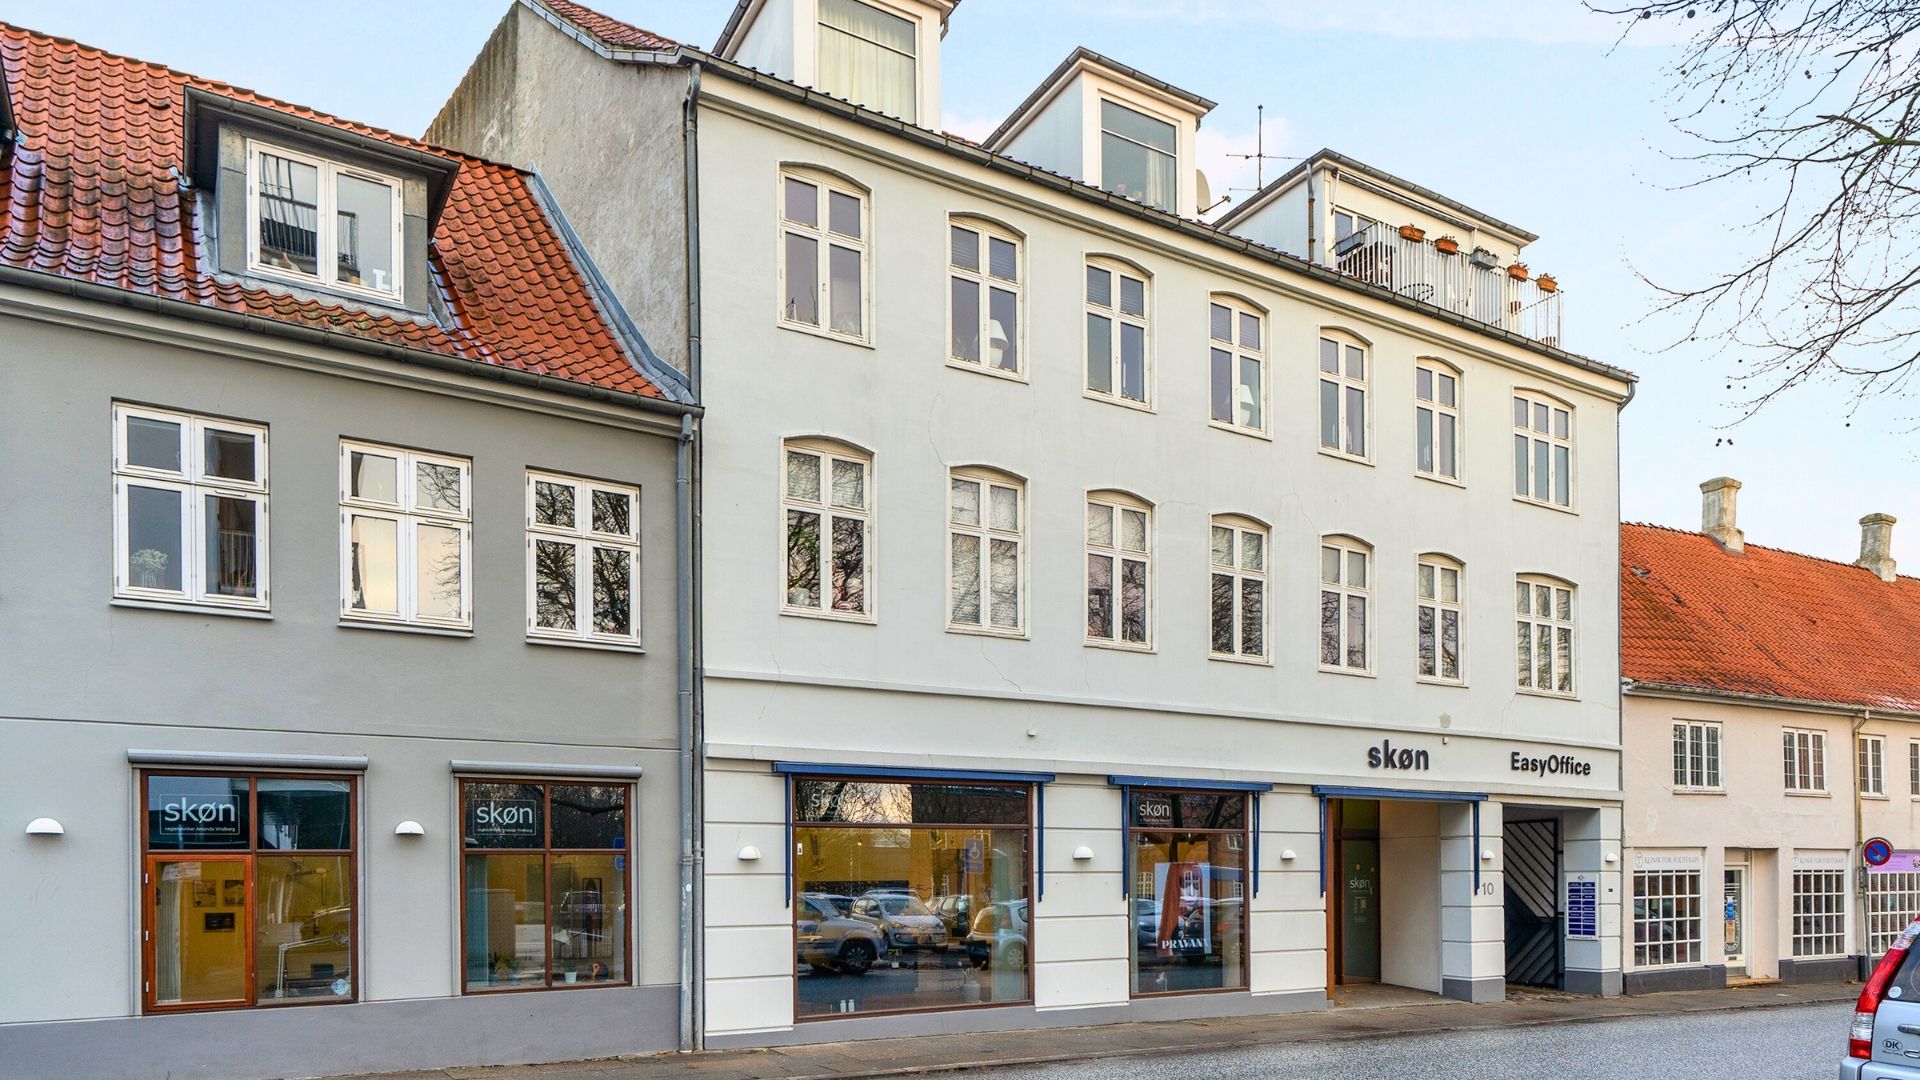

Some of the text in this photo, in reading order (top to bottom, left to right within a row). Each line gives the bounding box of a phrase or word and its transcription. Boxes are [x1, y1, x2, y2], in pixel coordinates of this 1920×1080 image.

[1367, 739, 1430, 771] skøn
[1510, 751, 1592, 777] EasyOffice
[164, 797, 236, 823] skøn
[476, 801, 533, 825] skøn
[1139, 801, 1170, 817] skøn
[1350, 877, 1370, 889] skøn
[1482, 882, 1494, 896] 10
[1161, 938, 1209, 949] PRAVANA
[1885, 1041, 1899, 1050] DK
